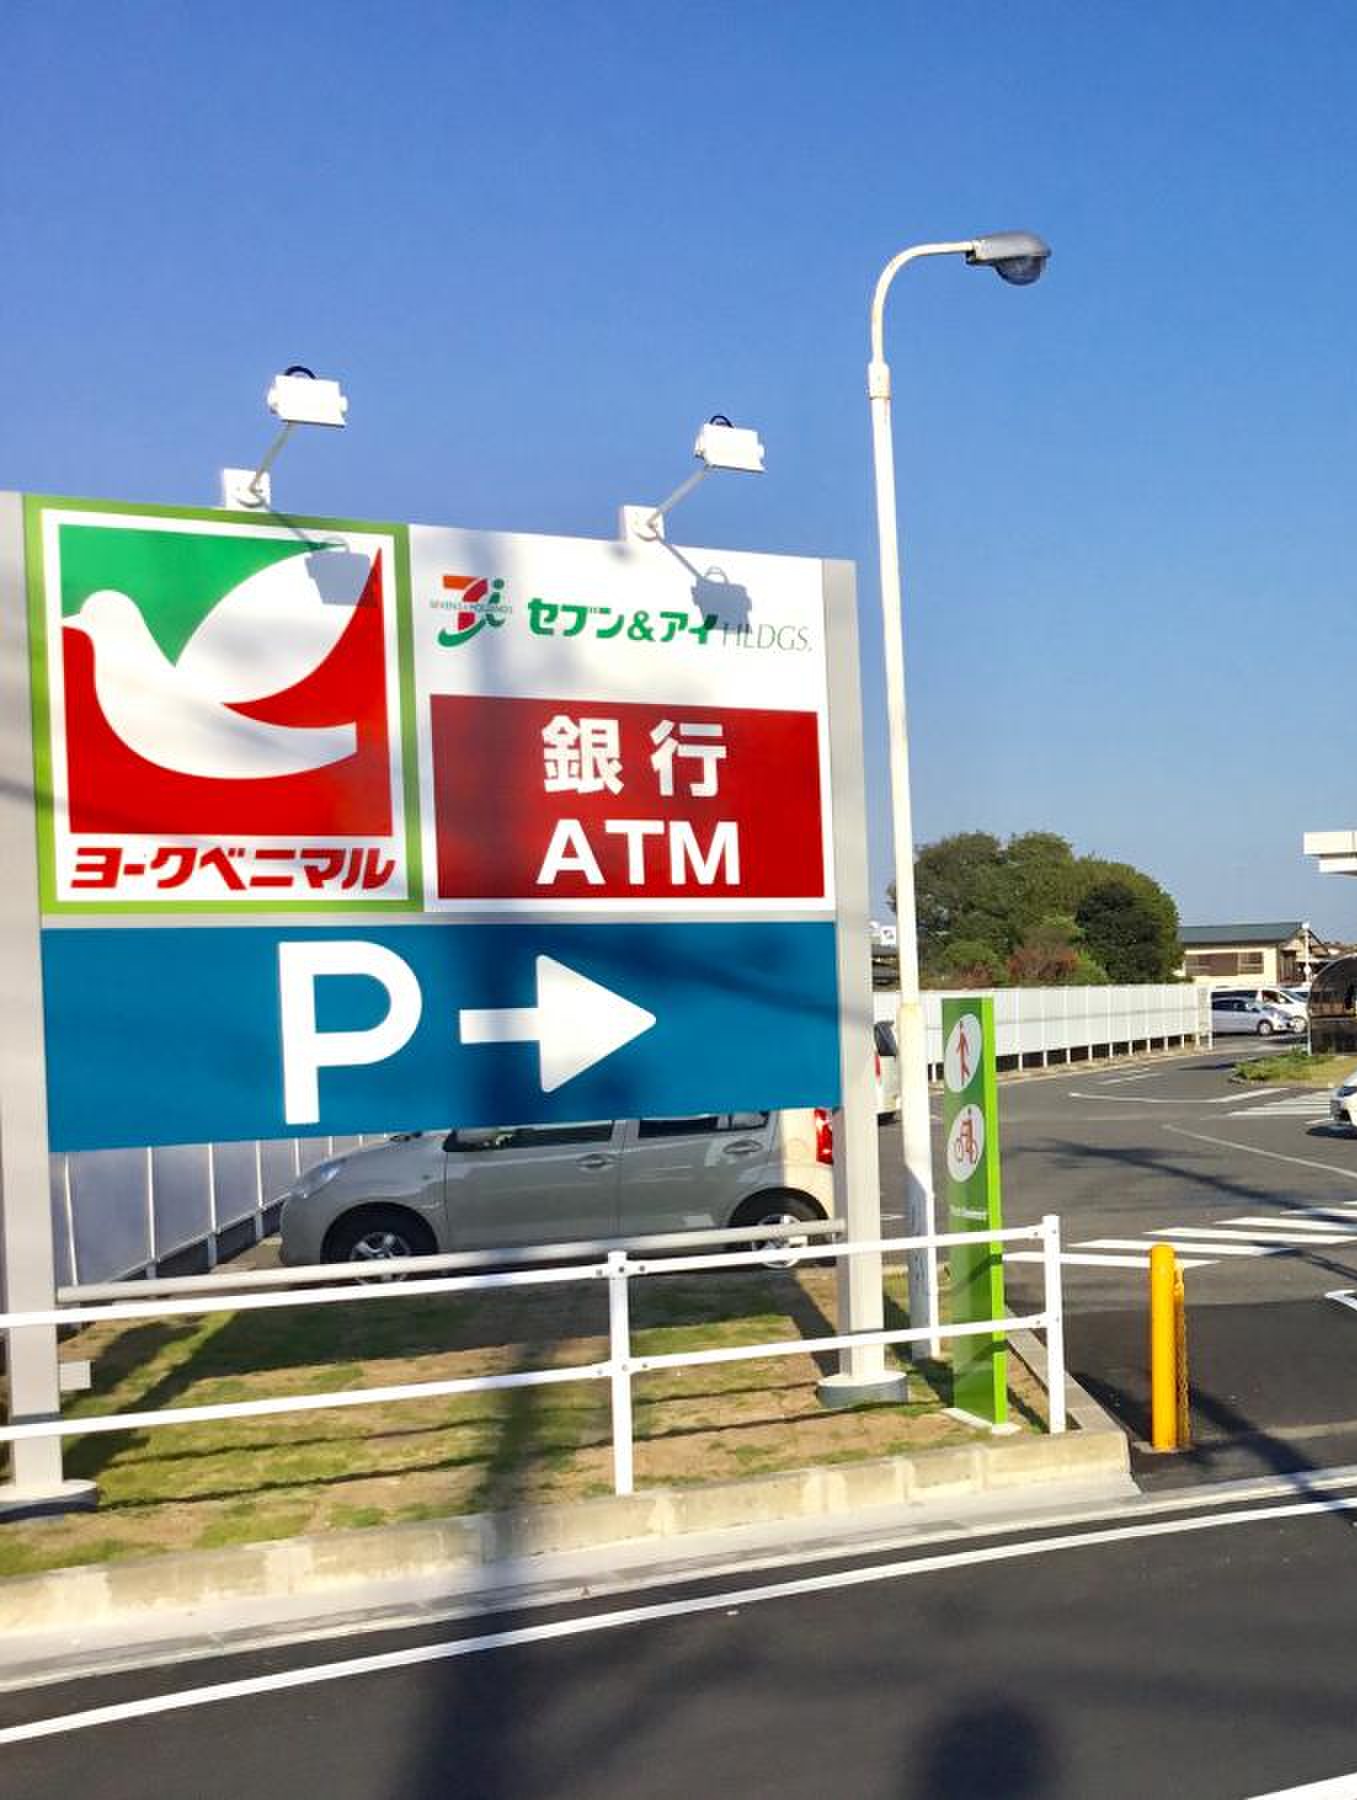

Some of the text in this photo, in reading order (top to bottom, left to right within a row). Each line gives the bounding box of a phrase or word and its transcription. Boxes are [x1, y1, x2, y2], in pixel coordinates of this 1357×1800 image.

[541, 715, 726, 797] 銀行
[71, 847, 395, 890] ヨークベニマル
[537, 819, 740, 885] ATM
[277, 941, 422, 1124] P
